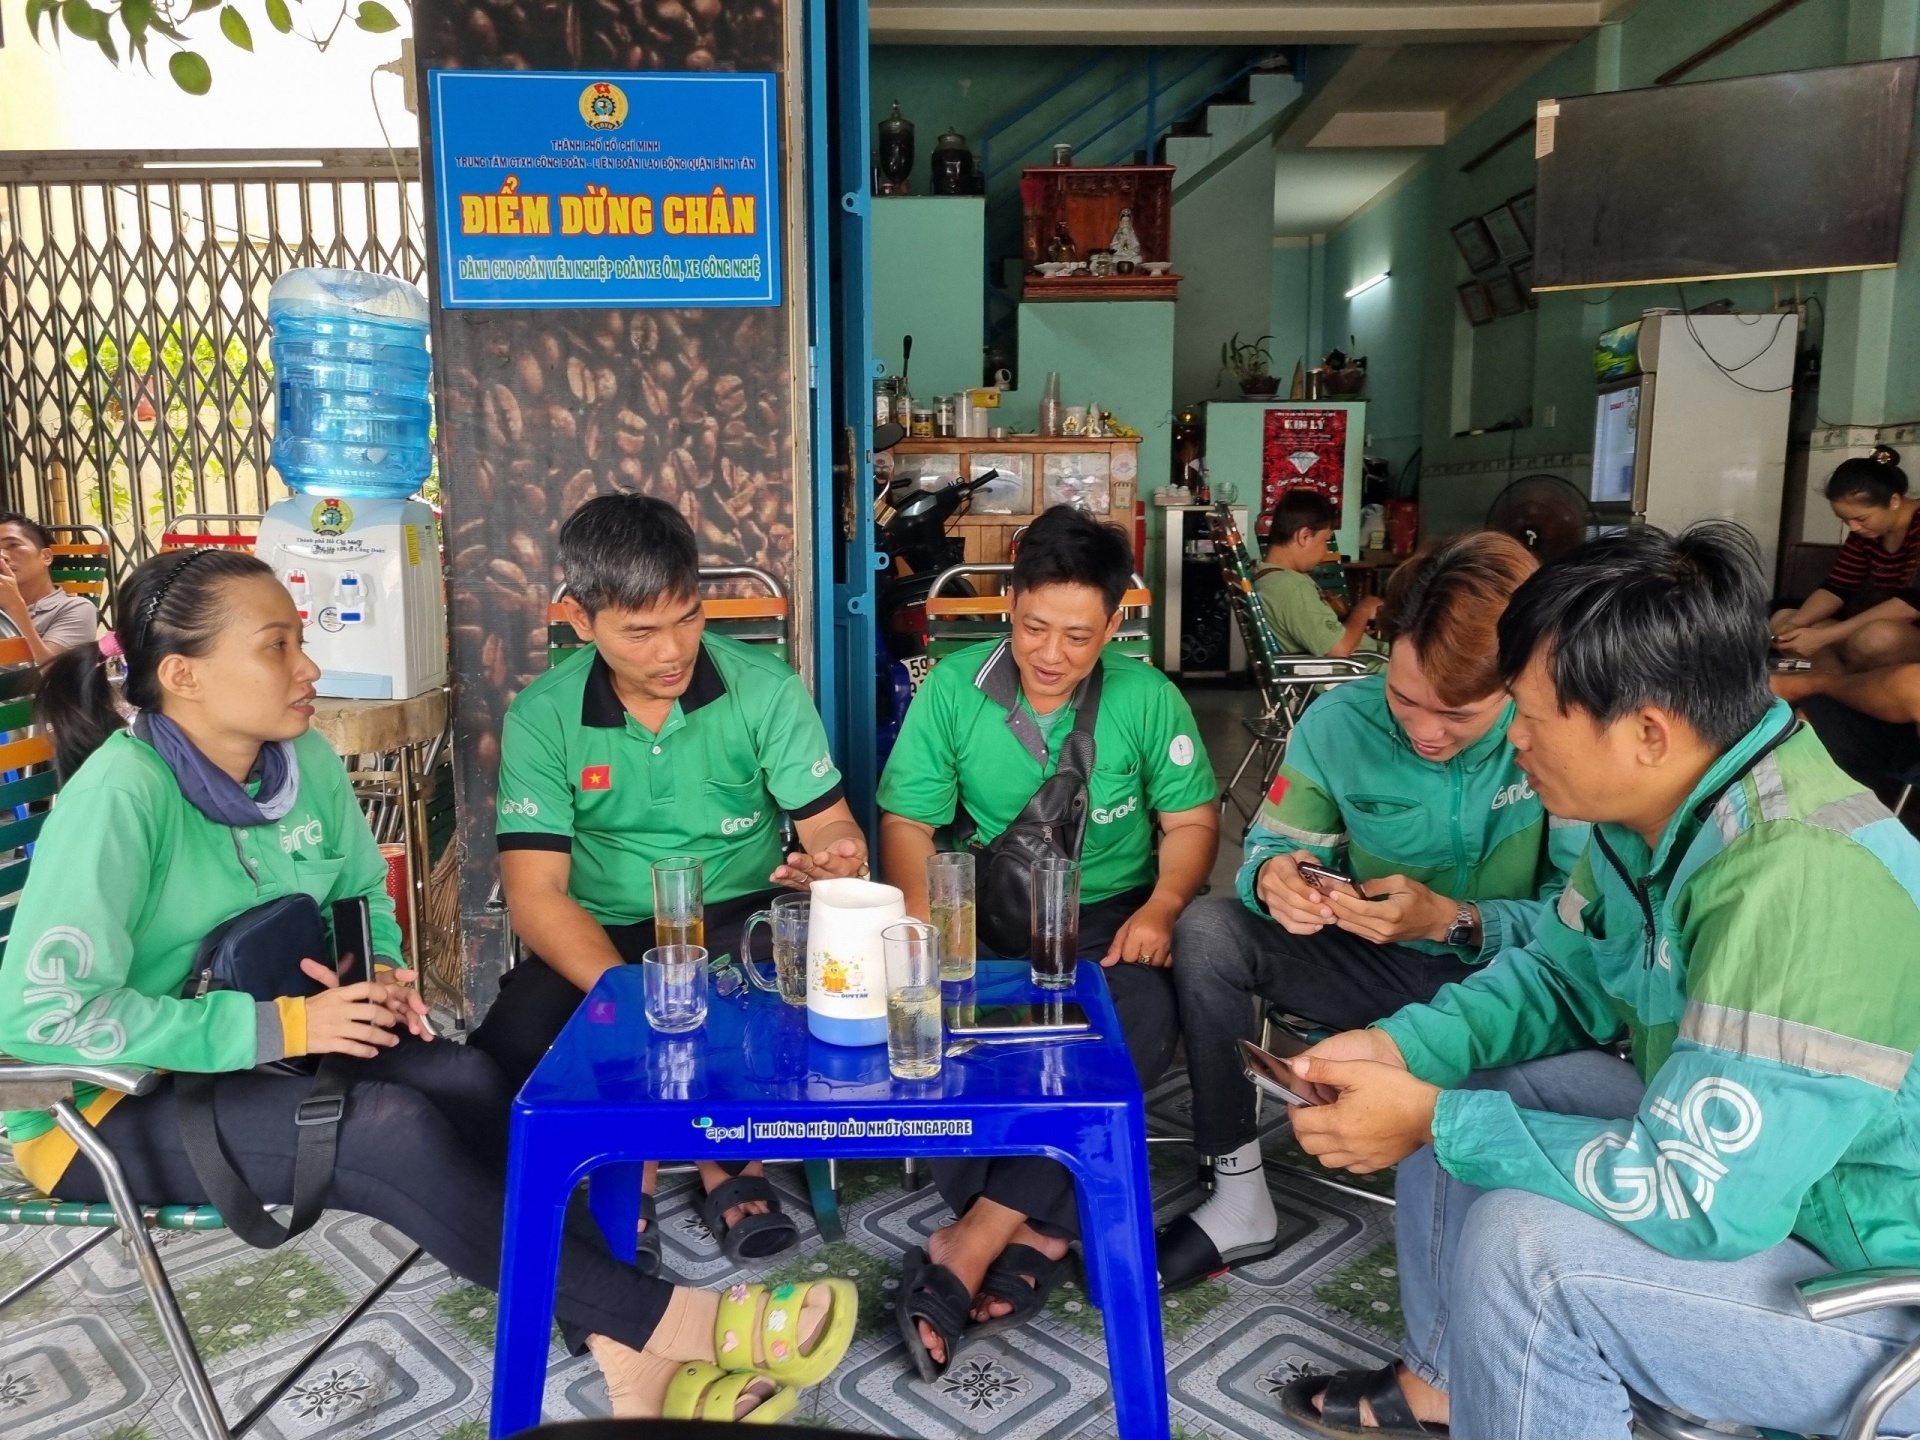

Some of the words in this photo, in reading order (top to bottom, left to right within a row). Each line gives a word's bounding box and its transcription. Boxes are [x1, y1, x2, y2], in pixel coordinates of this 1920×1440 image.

[551, 138, 582, 151] THÀNH
[583, 136, 603, 151] PHỐ
[604, 137, 617, 151] HỒ
[620, 138, 635, 151] CHÍ
[637, 141, 660, 151] MINH
[455, 156, 486, 168] TRUNG
[487, 154, 508, 168] TÂM
[535, 154, 559, 168] CÔNG
[561, 155, 587, 169] ĐOÀN
[592, 155, 614, 169] LIÊN
[616, 155, 640, 169] ĐOÀN
[642, 158, 660, 169] LAO
[661, 156, 686, 171] ĐỘNG
[687, 156, 712, 171] QUẬN
[714, 157, 735, 169] BÌNH
[737, 156, 756, 169] TÂN
[460, 174, 552, 235] ĐIỂM
[559, 183, 654, 235] DỪNG
[662, 185, 756, 235] CHÂN
[459, 255, 491, 280] DÀNH
[492, 260, 514, 280] CHO
[515, 255, 546, 280] ĐOÀN
[546, 255, 573, 280] VIÊN
[574, 255, 614, 283] NGHIỆP
[615, 255, 645, 279] ĐOÀN
[647, 259, 661, 279] XE
[662, 255, 684, 282] ÔM,
[685, 259, 700, 279] XE
[702, 254, 730, 278] CÔNG
[732, 254, 761, 281] NGHỆ
[910, 657, 928, 678] 59
[754, 1120, 805, 1138] THƯƠNG
[806, 1120, 837, 1140] HIỆU
[838, 1117, 866, 1138] DẦU
[867, 1118, 902, 1138] NHỚT
[902, 1119, 973, 1137] SINGAPORE
